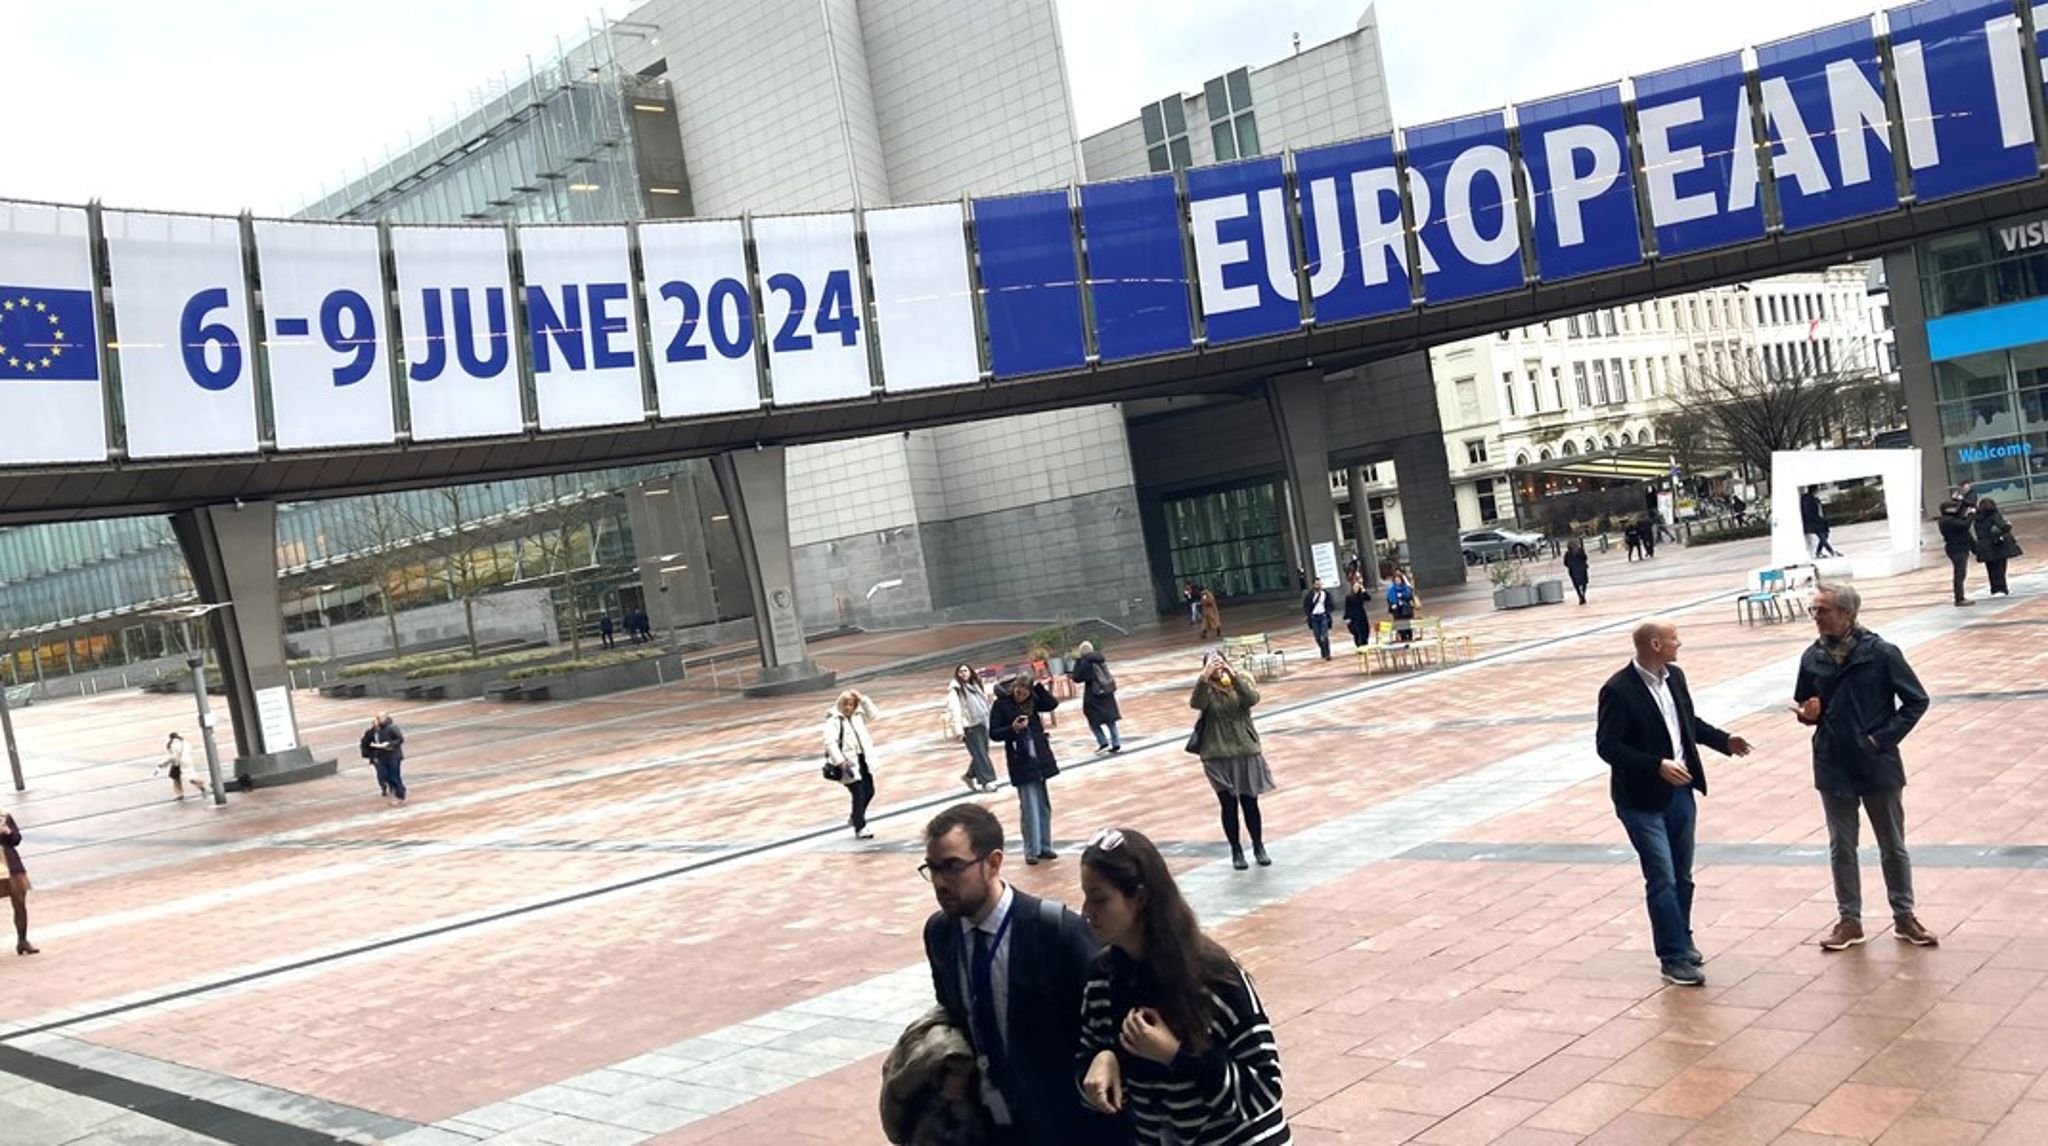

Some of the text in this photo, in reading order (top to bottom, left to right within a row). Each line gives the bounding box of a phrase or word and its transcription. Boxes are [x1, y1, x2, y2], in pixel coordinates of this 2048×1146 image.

[1188, 40, 1940, 316] EUROPEAN
[409, 283, 636, 383] JUNE
[660, 270, 861, 363] 2024
[1959, 441, 2033, 463] Welcome
